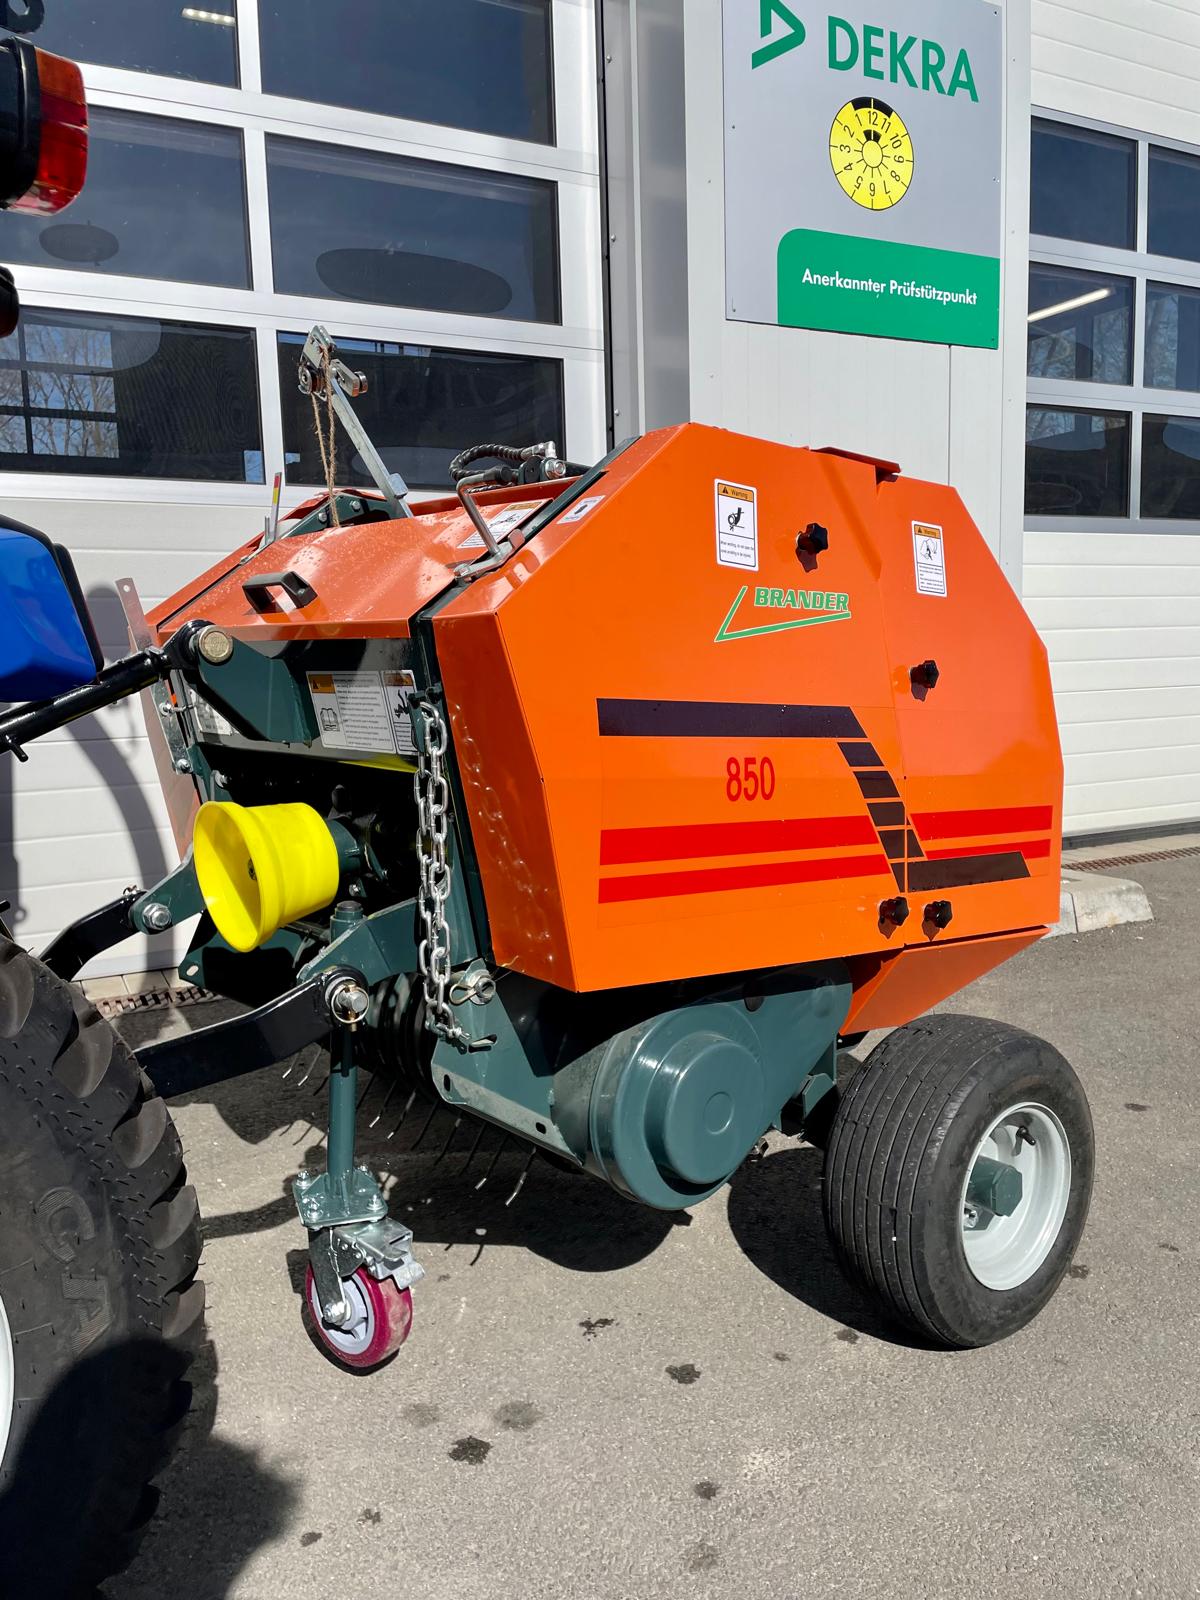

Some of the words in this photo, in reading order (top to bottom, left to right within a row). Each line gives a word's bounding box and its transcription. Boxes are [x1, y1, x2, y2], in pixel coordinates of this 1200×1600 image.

[828, 15, 979, 103] DEKRA
[855, 113, 863, 127] 1
[868, 110, 879, 126] 12
[843, 125, 854, 138] 2
[881, 118, 892, 133] 11
[890, 133, 903, 149] 10
[839, 144, 851, 153] 3
[843, 162, 853, 171] 4
[893, 155, 905, 164] 9
[854, 176, 863, 189] 5
[890, 170, 901, 182] 8
[883, 180, 891, 195] 7
[801, 267, 887, 293] Anerkannter
[889, 279, 978, 306] Prüfstützpunkt
[731, 488, 748, 500] Warning
[753, 587, 850, 612] BRANDER
[725, 756, 775, 803] 850
